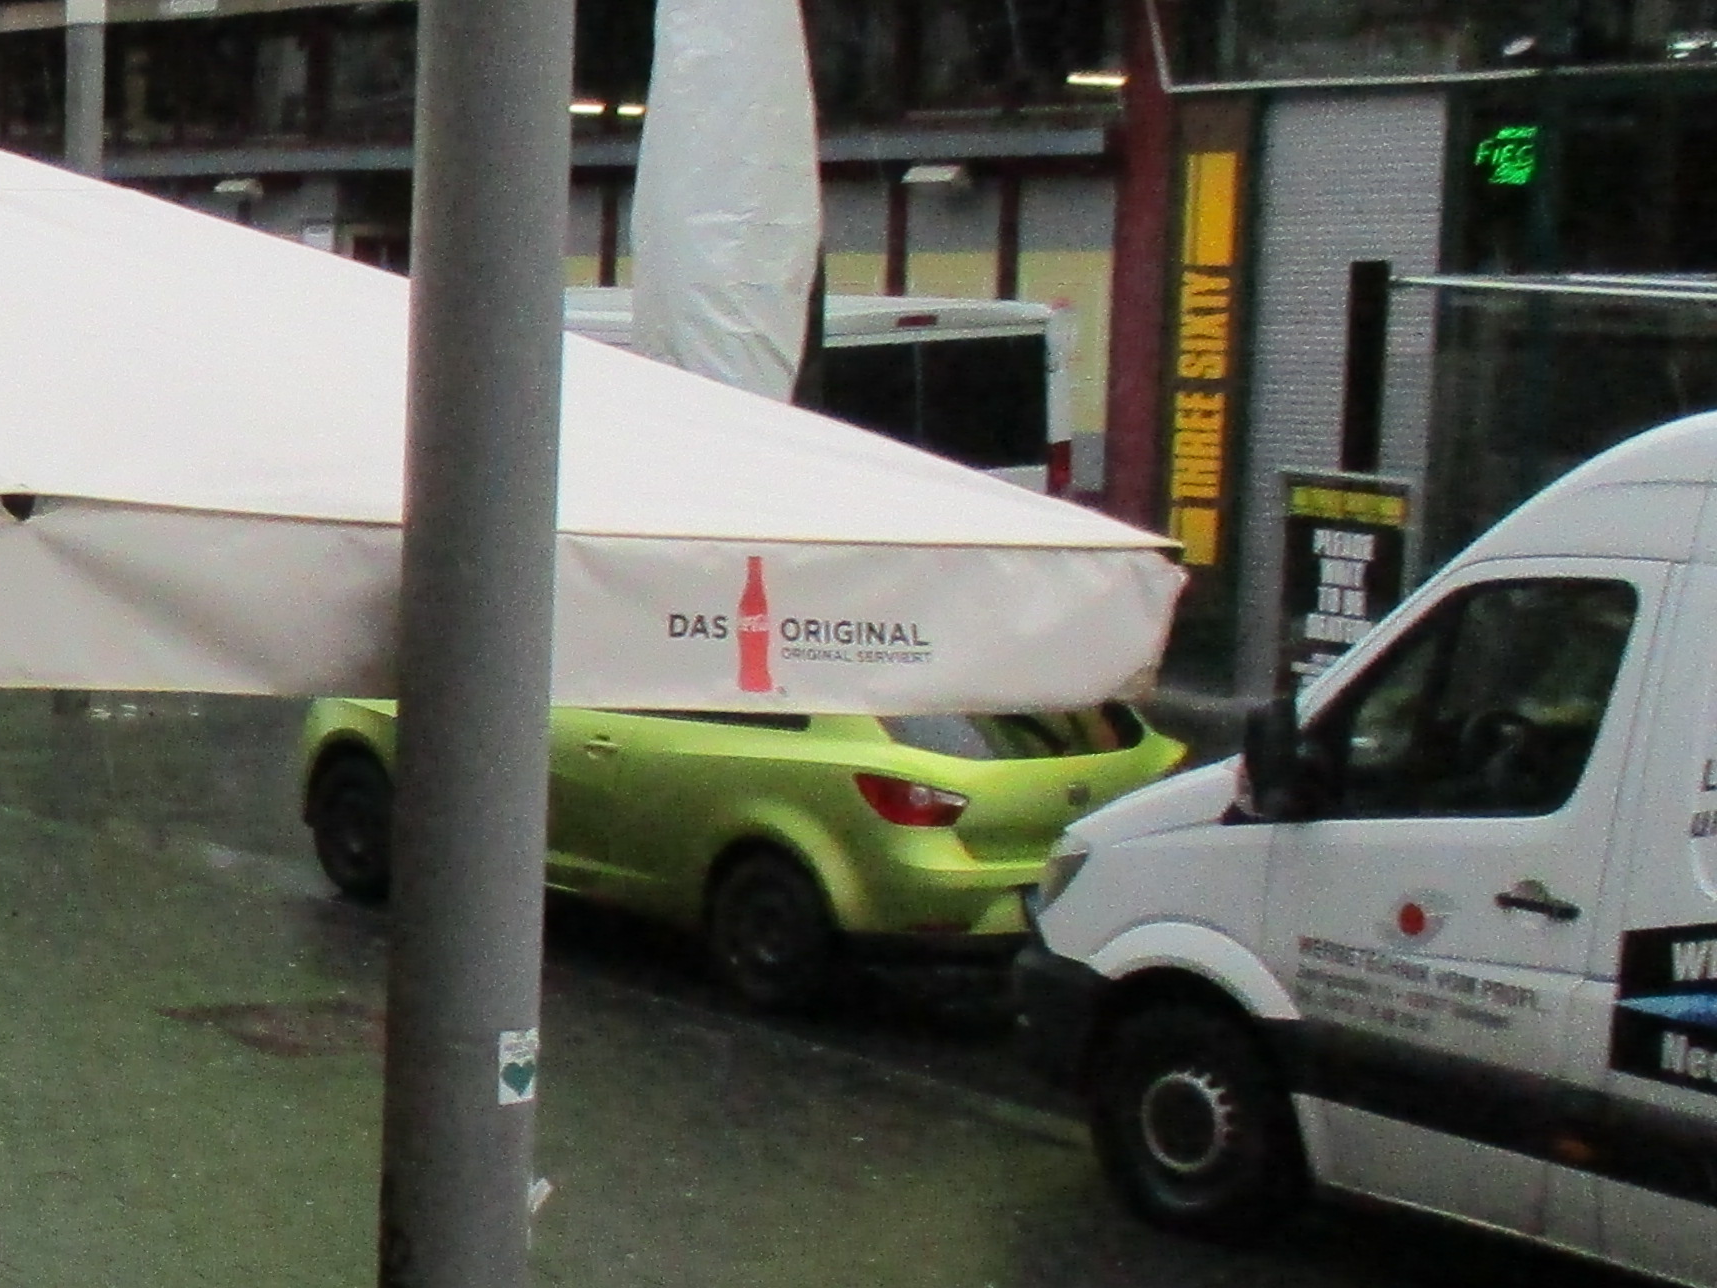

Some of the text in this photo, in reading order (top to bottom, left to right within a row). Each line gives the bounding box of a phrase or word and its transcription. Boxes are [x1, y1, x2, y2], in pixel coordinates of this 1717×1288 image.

[1172, 270, 1231, 499] THREE SIXTY
[668, 613, 729, 640] DAS
[780, 617, 931, 647] ORIGINAL
[781, 646, 852, 663] ORIGINAL
